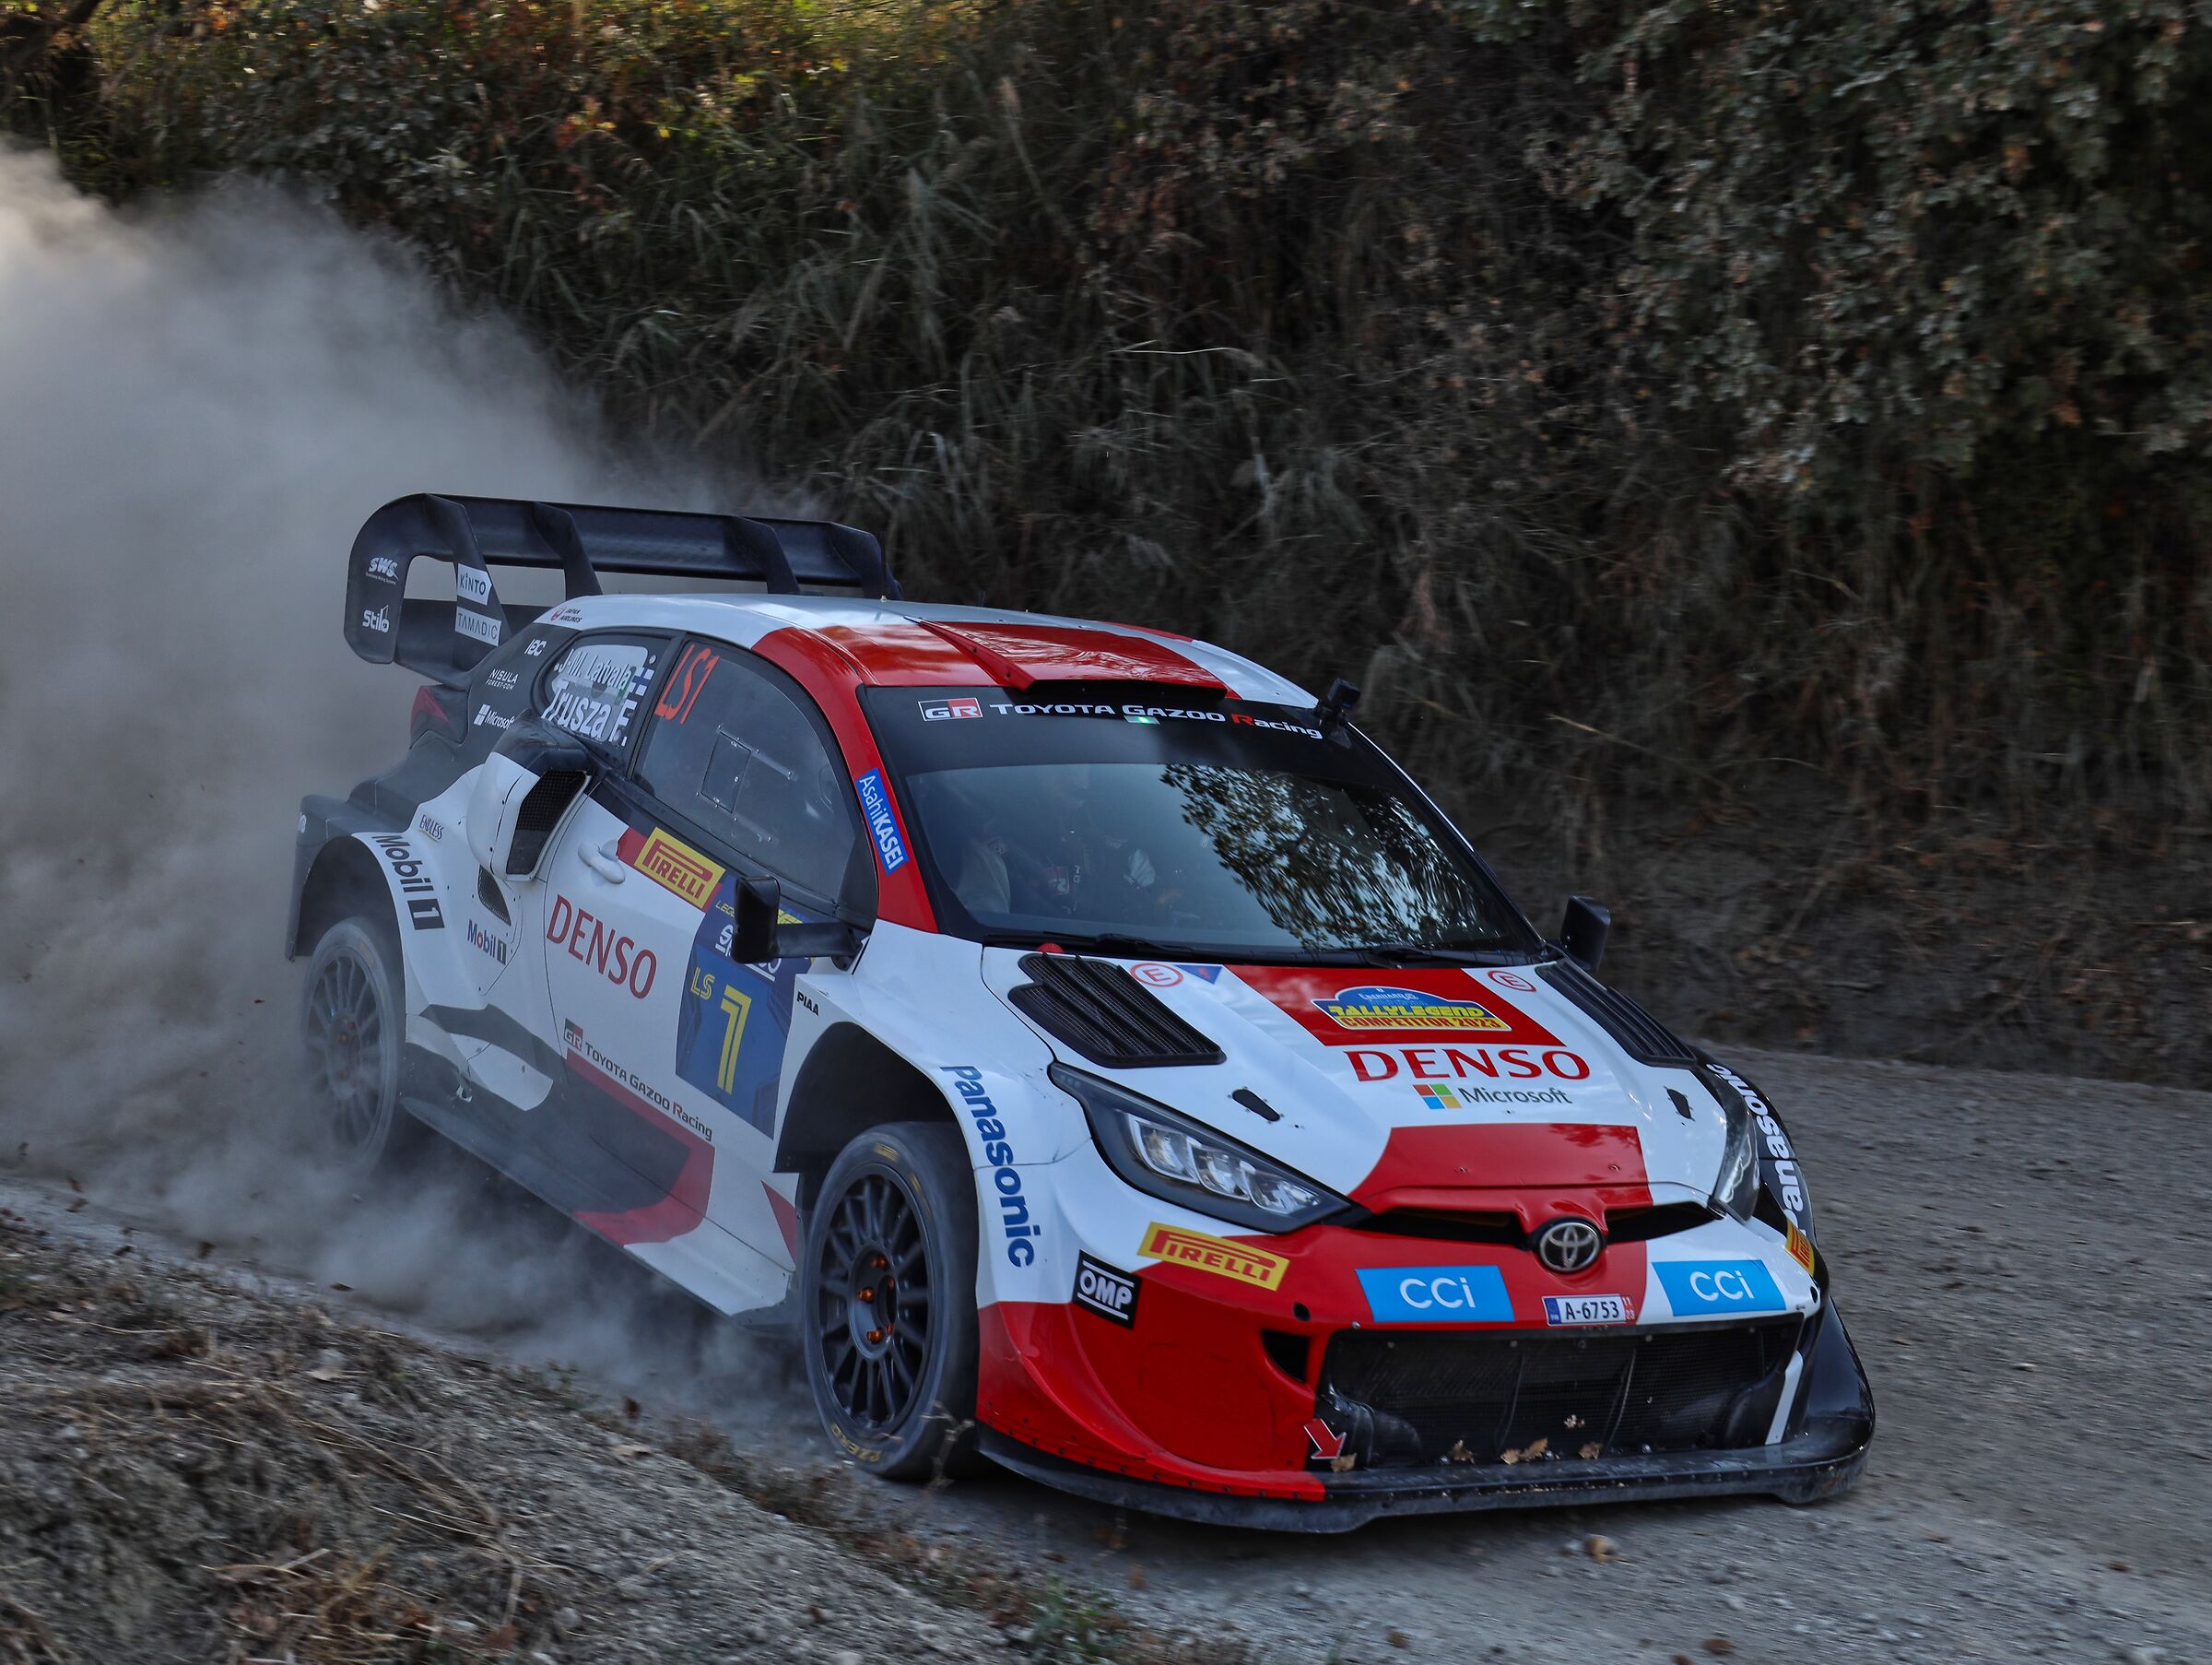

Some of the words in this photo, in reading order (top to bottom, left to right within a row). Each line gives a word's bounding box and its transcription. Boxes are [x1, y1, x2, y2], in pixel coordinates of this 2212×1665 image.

[369, 557, 399, 580] SWS
[362, 605, 390, 633] Stilo
[457, 613, 498, 640] TAMADIC
[488, 668, 519, 684] NISULA
[540, 679, 613, 739] Trusza
[924, 705, 979, 720] GR
[990, 703, 1116, 715] TOYOTA
[1122, 704, 1226, 722] GAZOO
[1231, 714, 1324, 739] Racing
[418, 814, 444, 840] ENDLESS
[371, 834, 435, 893] Mobil
[641, 838, 714, 900] PIRELLI
[466, 918, 496, 959] Mobil
[546, 893, 658, 1000] DENSO
[690, 966, 715, 1000] LS
[796, 991, 819, 1016] PIAA
[1340, 1017, 1453, 1027] COMPETITOR
[1453, 1017, 1502, 1028] 2023
[1343, 1048, 1590, 1082] DENSO
[564, 1029, 582, 1051] GR
[585, 1042, 627, 1081] TOYOTA
[629, 1074, 671, 1111] GAZOO
[672, 1101, 713, 1142] Racing
[1458, 1085, 1572, 1104] Microsoft
[939, 1065, 1041, 1269] Panasonic
[1149, 1227, 1277, 1283] PIRELLI
[1079, 1270, 1134, 1310] OMP
[1565, 1300, 1620, 1320] A-6753
